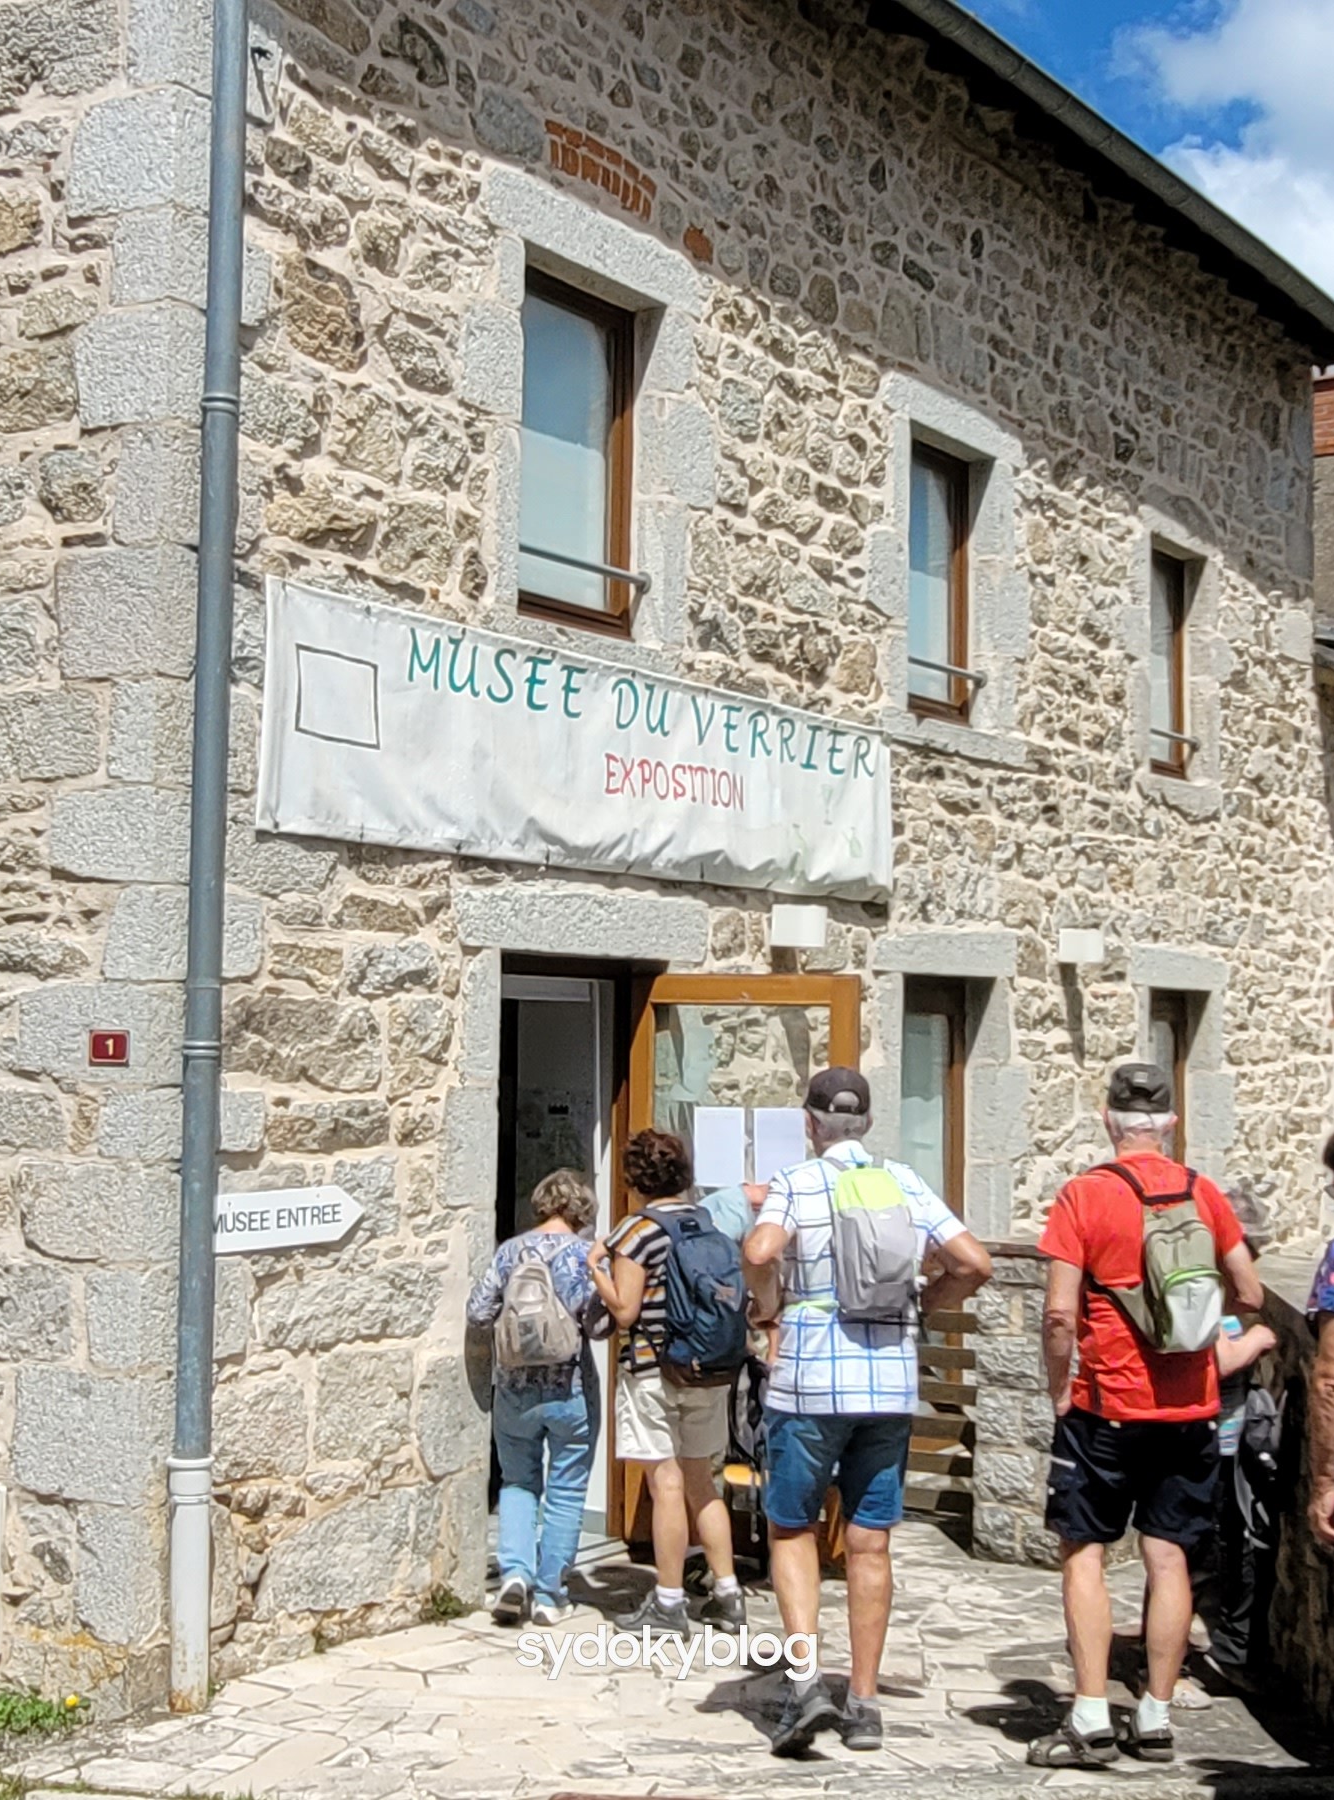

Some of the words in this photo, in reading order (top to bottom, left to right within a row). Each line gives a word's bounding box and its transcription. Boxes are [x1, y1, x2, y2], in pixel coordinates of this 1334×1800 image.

[611, 677, 671, 738] DU
[690, 694, 876, 779] VERRIER
[604, 752, 744, 812] EXPOSITION
[104, 1038, 114, 1056] 1
[276, 1203, 342, 1229] ENTREE
